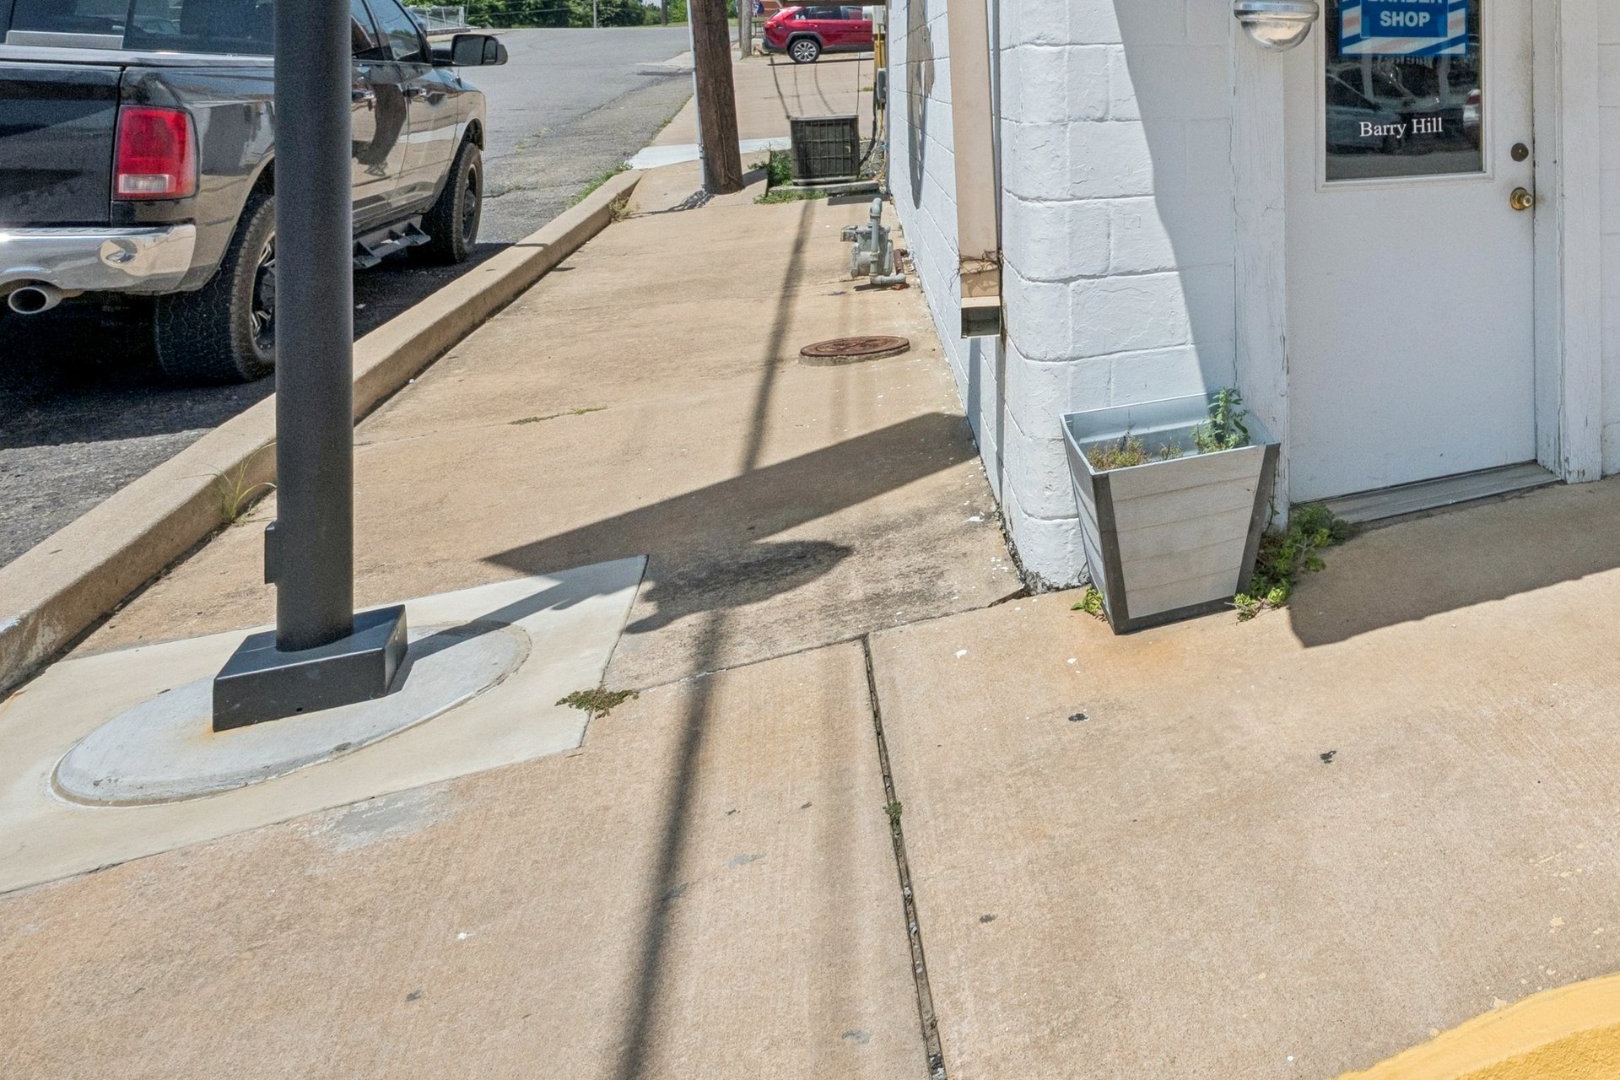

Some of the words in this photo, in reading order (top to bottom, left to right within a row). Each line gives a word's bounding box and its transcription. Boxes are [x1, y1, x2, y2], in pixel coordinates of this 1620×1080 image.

[1380, 10, 1431, 27] SHOP
[1359, 121, 1407, 139] Barry
[1411, 117, 1444, 134] Hill
